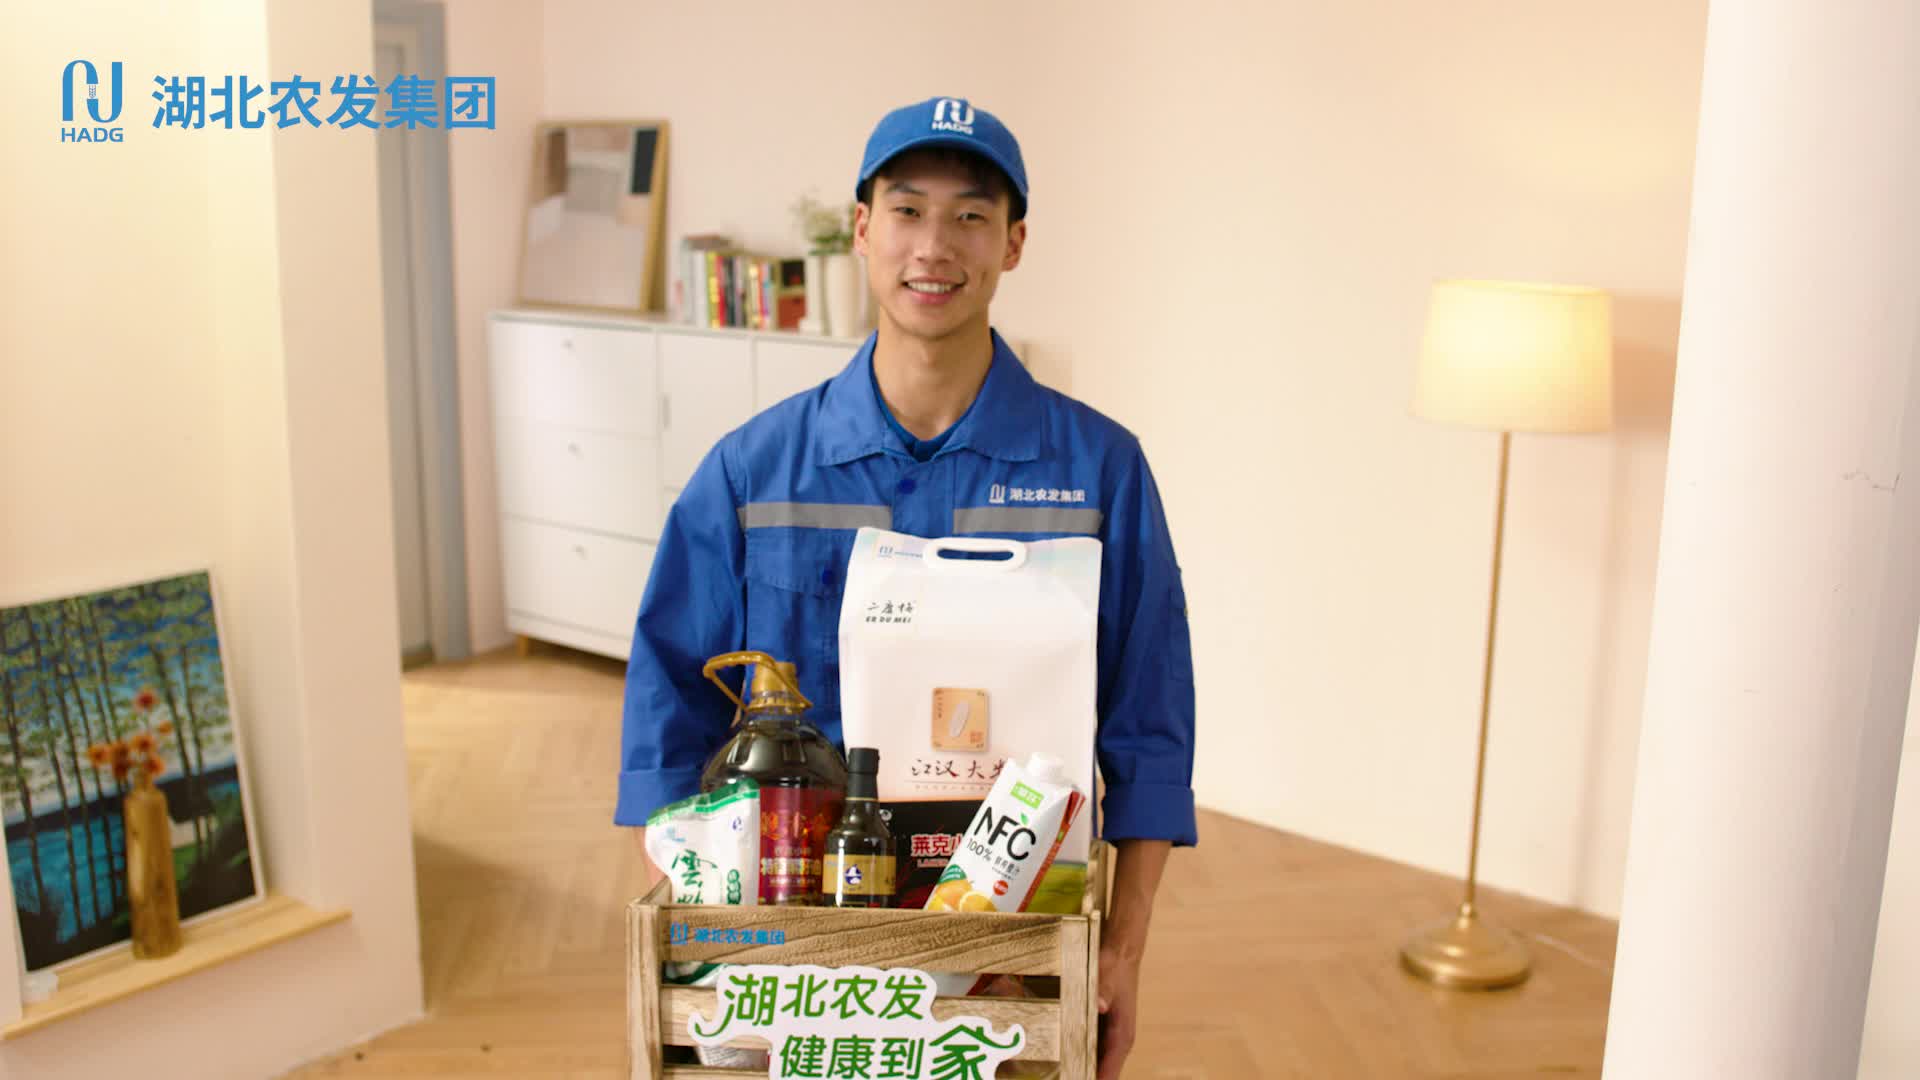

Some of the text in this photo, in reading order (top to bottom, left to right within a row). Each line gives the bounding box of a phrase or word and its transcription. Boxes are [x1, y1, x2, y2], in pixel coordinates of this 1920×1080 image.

[1009, 487, 1085, 502] 湖北农发集团
[967, 838, 993, 862] 100%
[974, 806, 1037, 861] NFC
[694, 927, 785, 945] 湖北农发集团
[694, 974, 928, 1037] 湖北农发
[779, 1024, 1021, 1080] 健康到家
